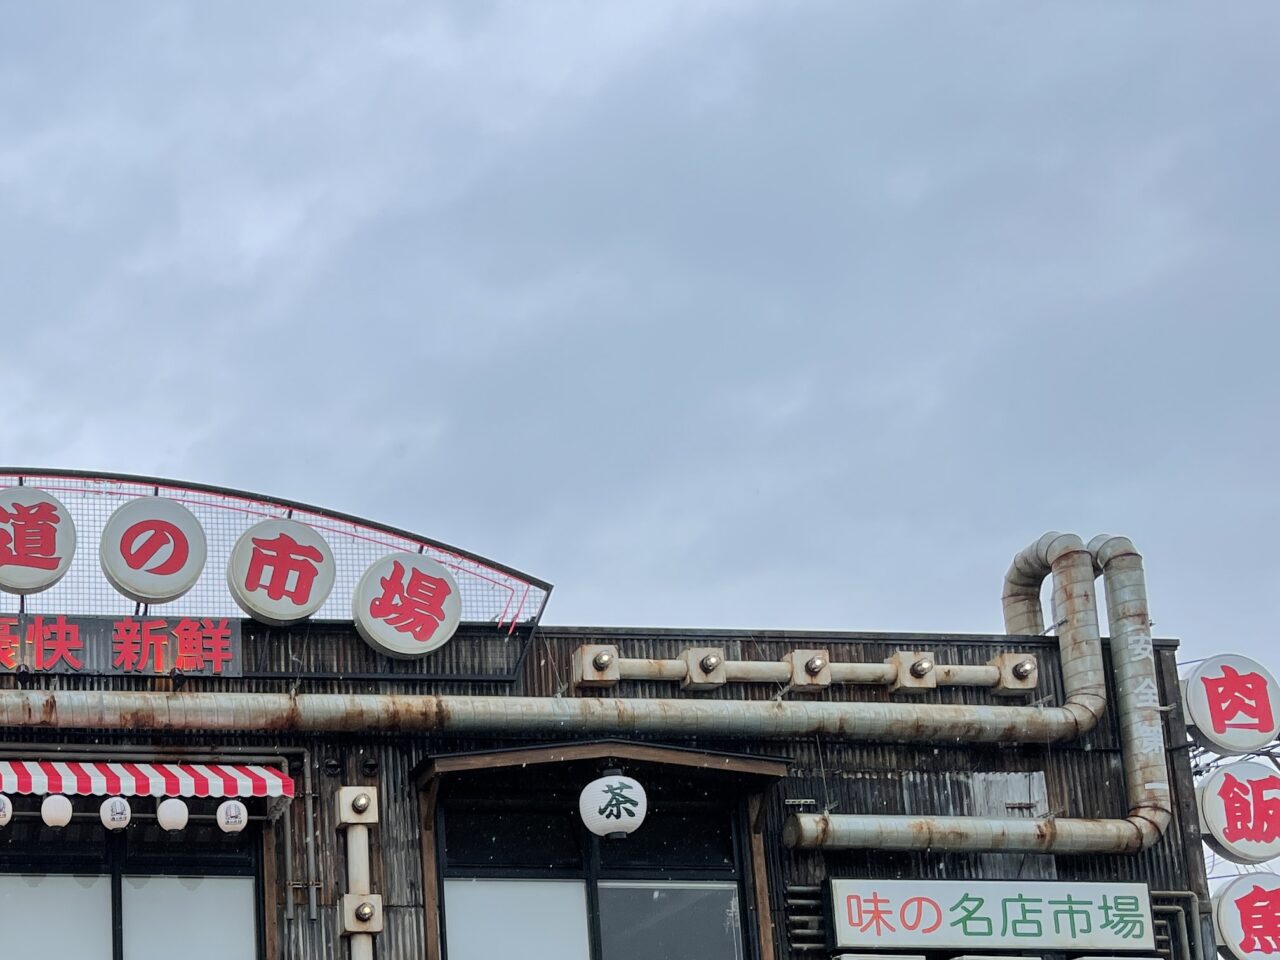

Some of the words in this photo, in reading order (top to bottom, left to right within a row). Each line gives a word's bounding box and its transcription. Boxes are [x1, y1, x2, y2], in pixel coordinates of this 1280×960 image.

[112, 617, 236, 675] 新鮮
[1201, 665, 1275, 735] 肉
[598, 781, 639, 820] 茶
[846, 891, 1145, 939] 味の名店市場
